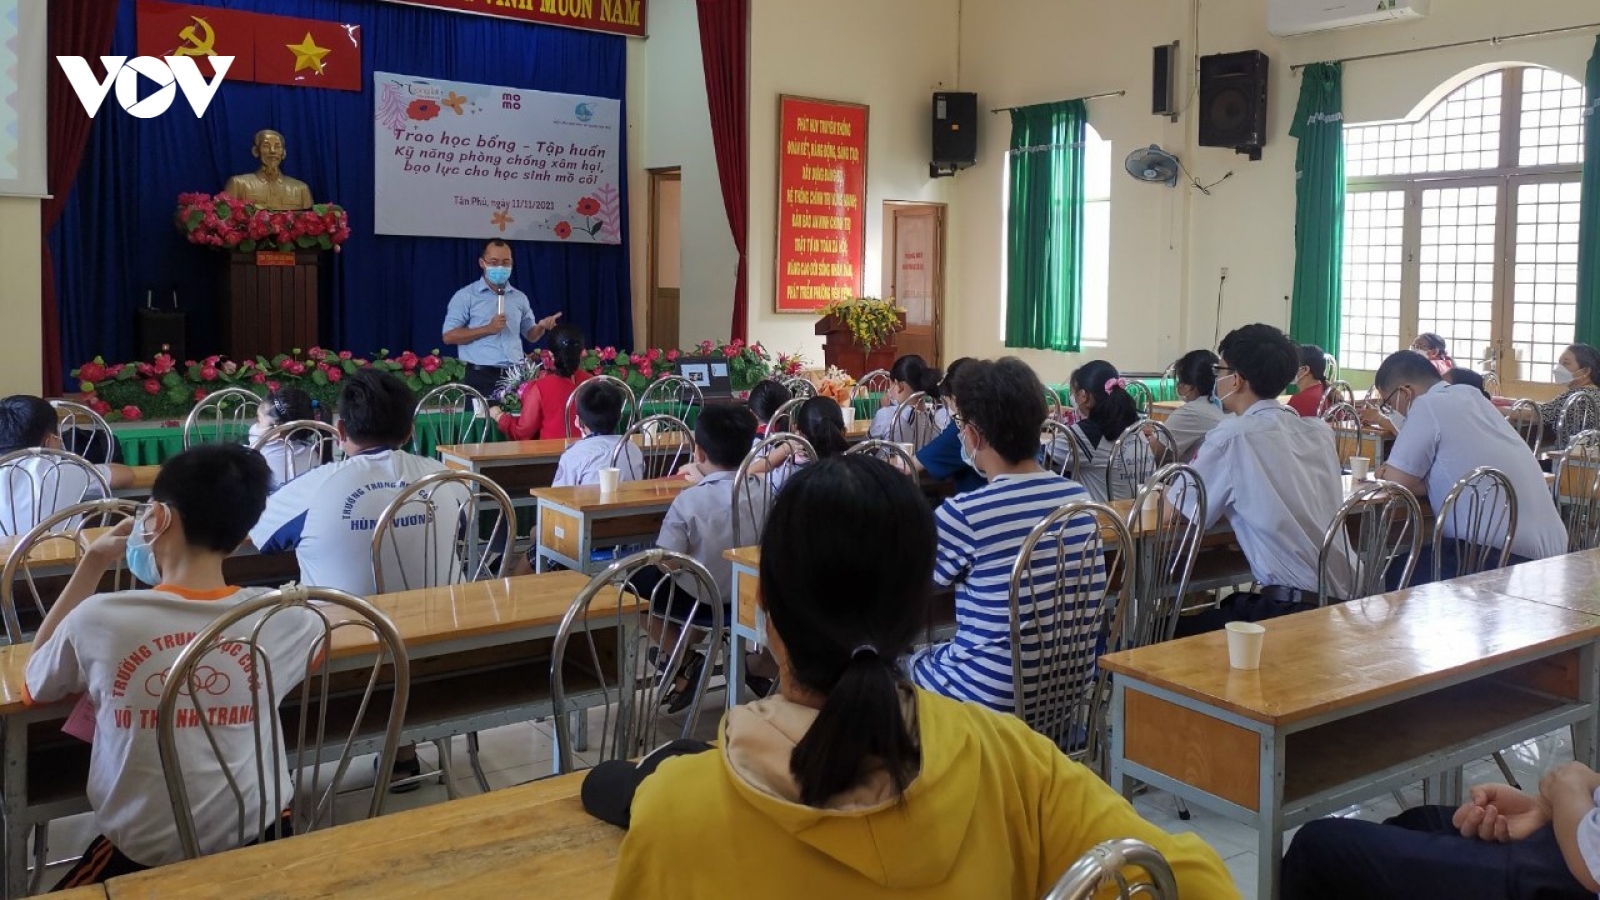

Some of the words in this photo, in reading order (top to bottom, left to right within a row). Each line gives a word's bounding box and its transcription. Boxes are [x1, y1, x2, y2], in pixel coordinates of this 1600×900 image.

[394, 128, 434, 143] Trao
[440, 131, 471, 148] học
[536, 141, 565, 156] Tập
[569, 143, 606, 158] huấn
[395, 146, 415, 159] Kỹ
[419, 148, 454, 162] năng
[459, 150, 502, 166] phòng
[506, 154, 546, 169] chống
[551, 159, 577, 170] xâm
[581, 159, 604, 173] hại,
[404, 160, 431, 174] bạo
[435, 162, 460, 176] lực
[464, 165, 490, 177] cho
[494, 167, 519, 180] học
[523, 170, 551, 182] sinh
[453, 195, 470, 206] Tân
[491, 198, 510, 211] ngày
[512, 199, 555, 210] 11/11/2021
[350, 517, 379, 531] HÙN
[112, 644, 152, 698] TRƯỜNG
[152, 632, 198, 652] TRUN
[114, 704, 132, 729] VÕ
[139, 708, 200, 729] THNH
[208, 704, 257, 727] TRAN
